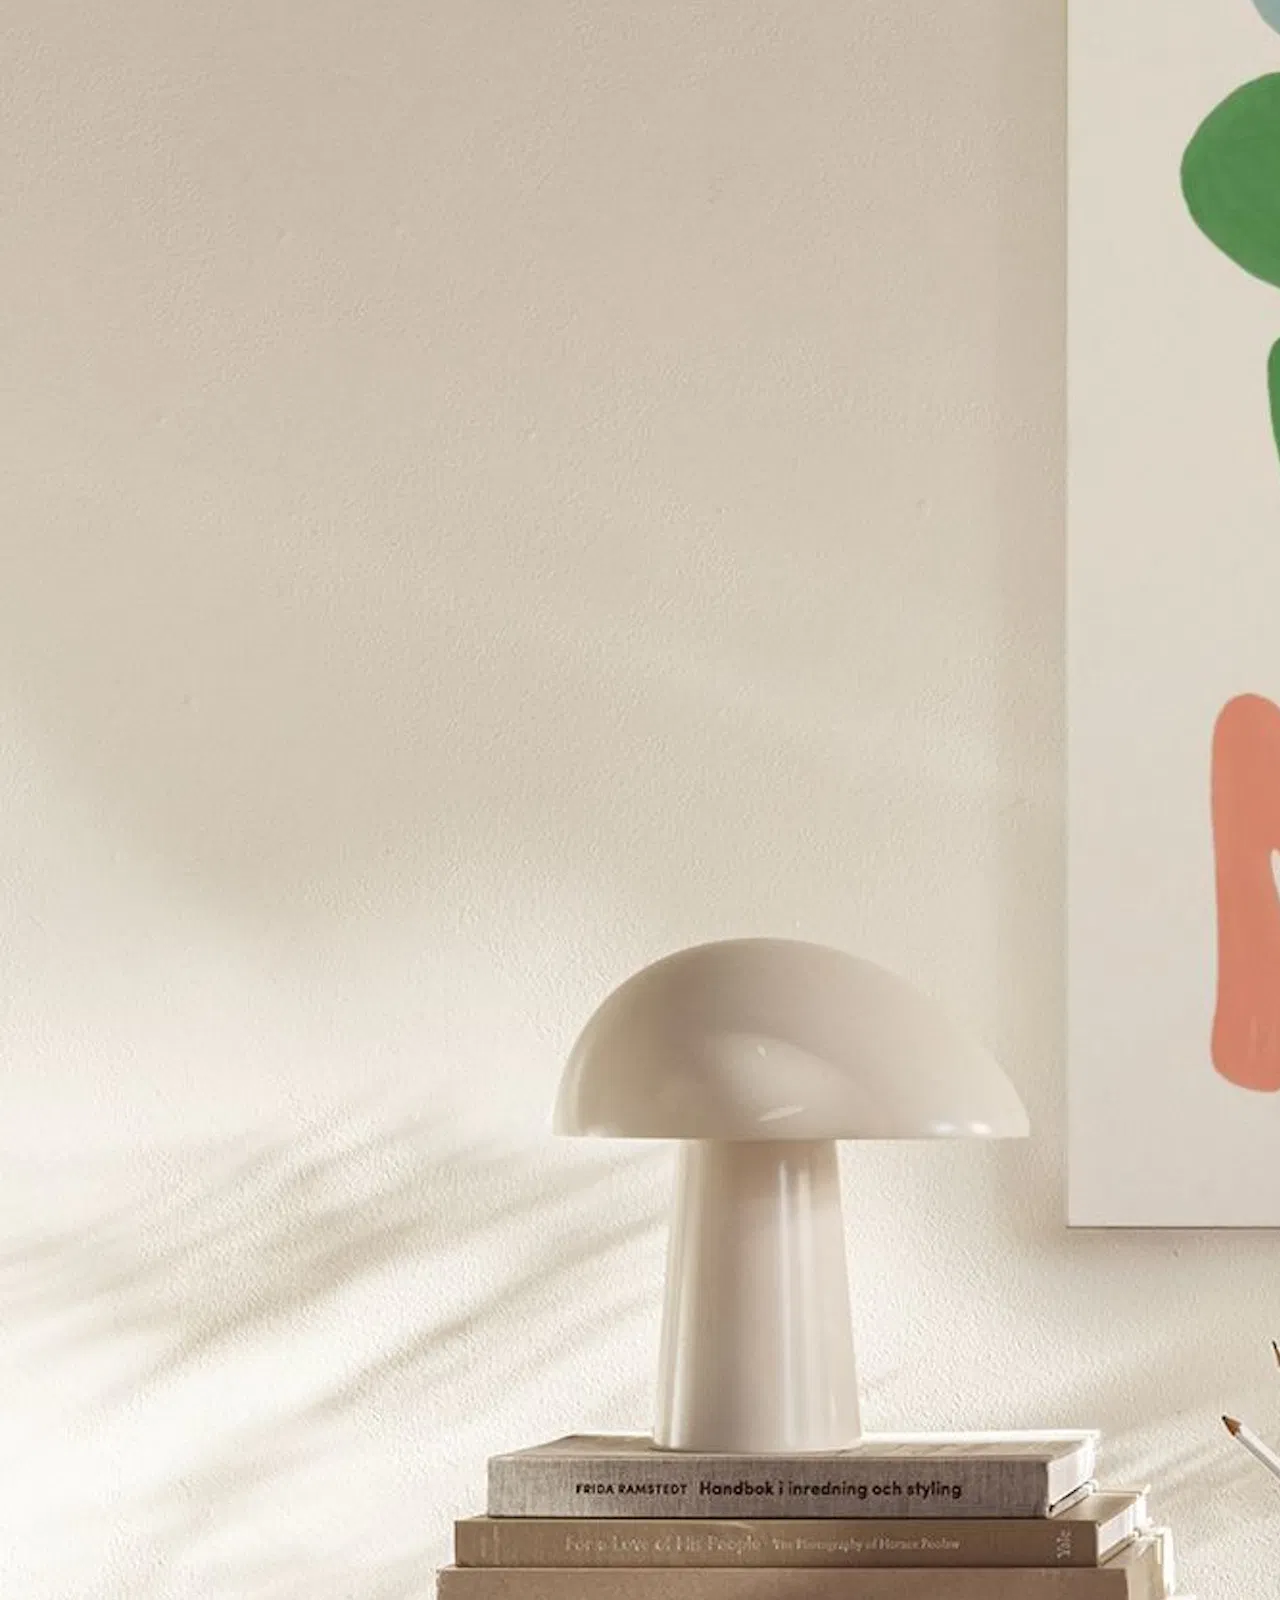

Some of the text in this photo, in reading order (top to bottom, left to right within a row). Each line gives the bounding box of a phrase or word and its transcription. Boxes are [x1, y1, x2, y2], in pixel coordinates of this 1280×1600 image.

[576, 1480, 962, 1500] FRIDA RAMSTEDT Handbok i inredning och styling
